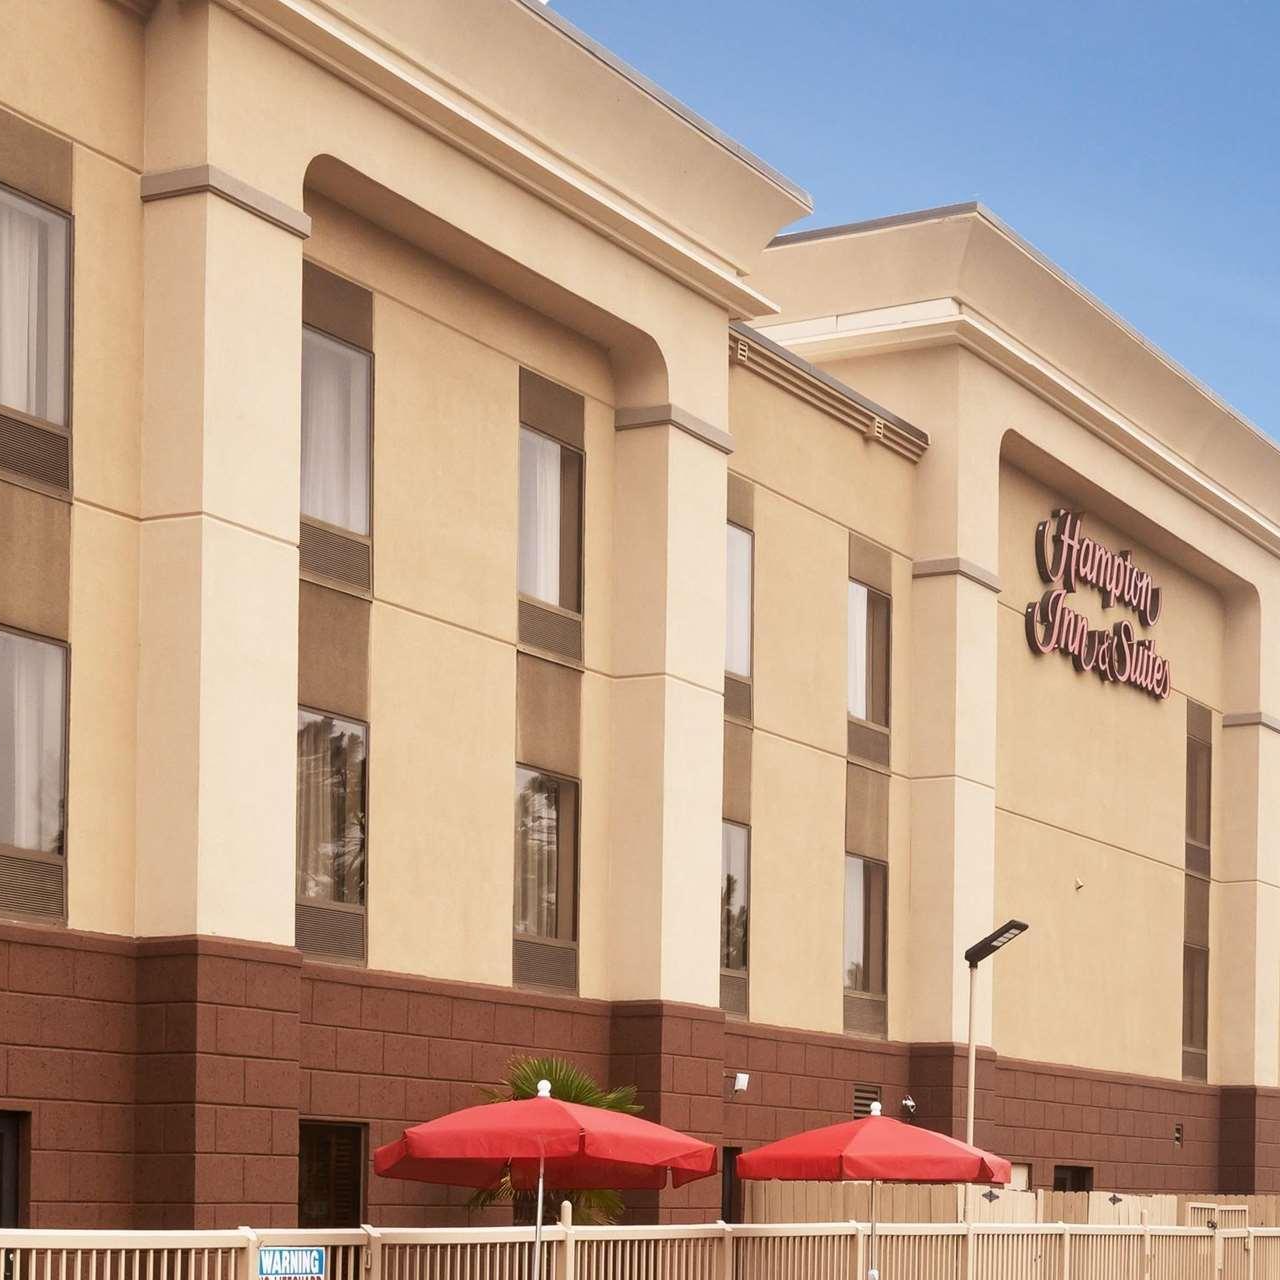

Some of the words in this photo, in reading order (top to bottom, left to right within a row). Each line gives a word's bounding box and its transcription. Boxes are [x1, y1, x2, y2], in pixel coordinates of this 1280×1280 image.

[1037, 509, 1163, 626] Hampton
[1026, 588, 1098, 672] Inn
[1113, 620, 1171, 700] Suites
[261, 1250, 319, 1274] WARNING
